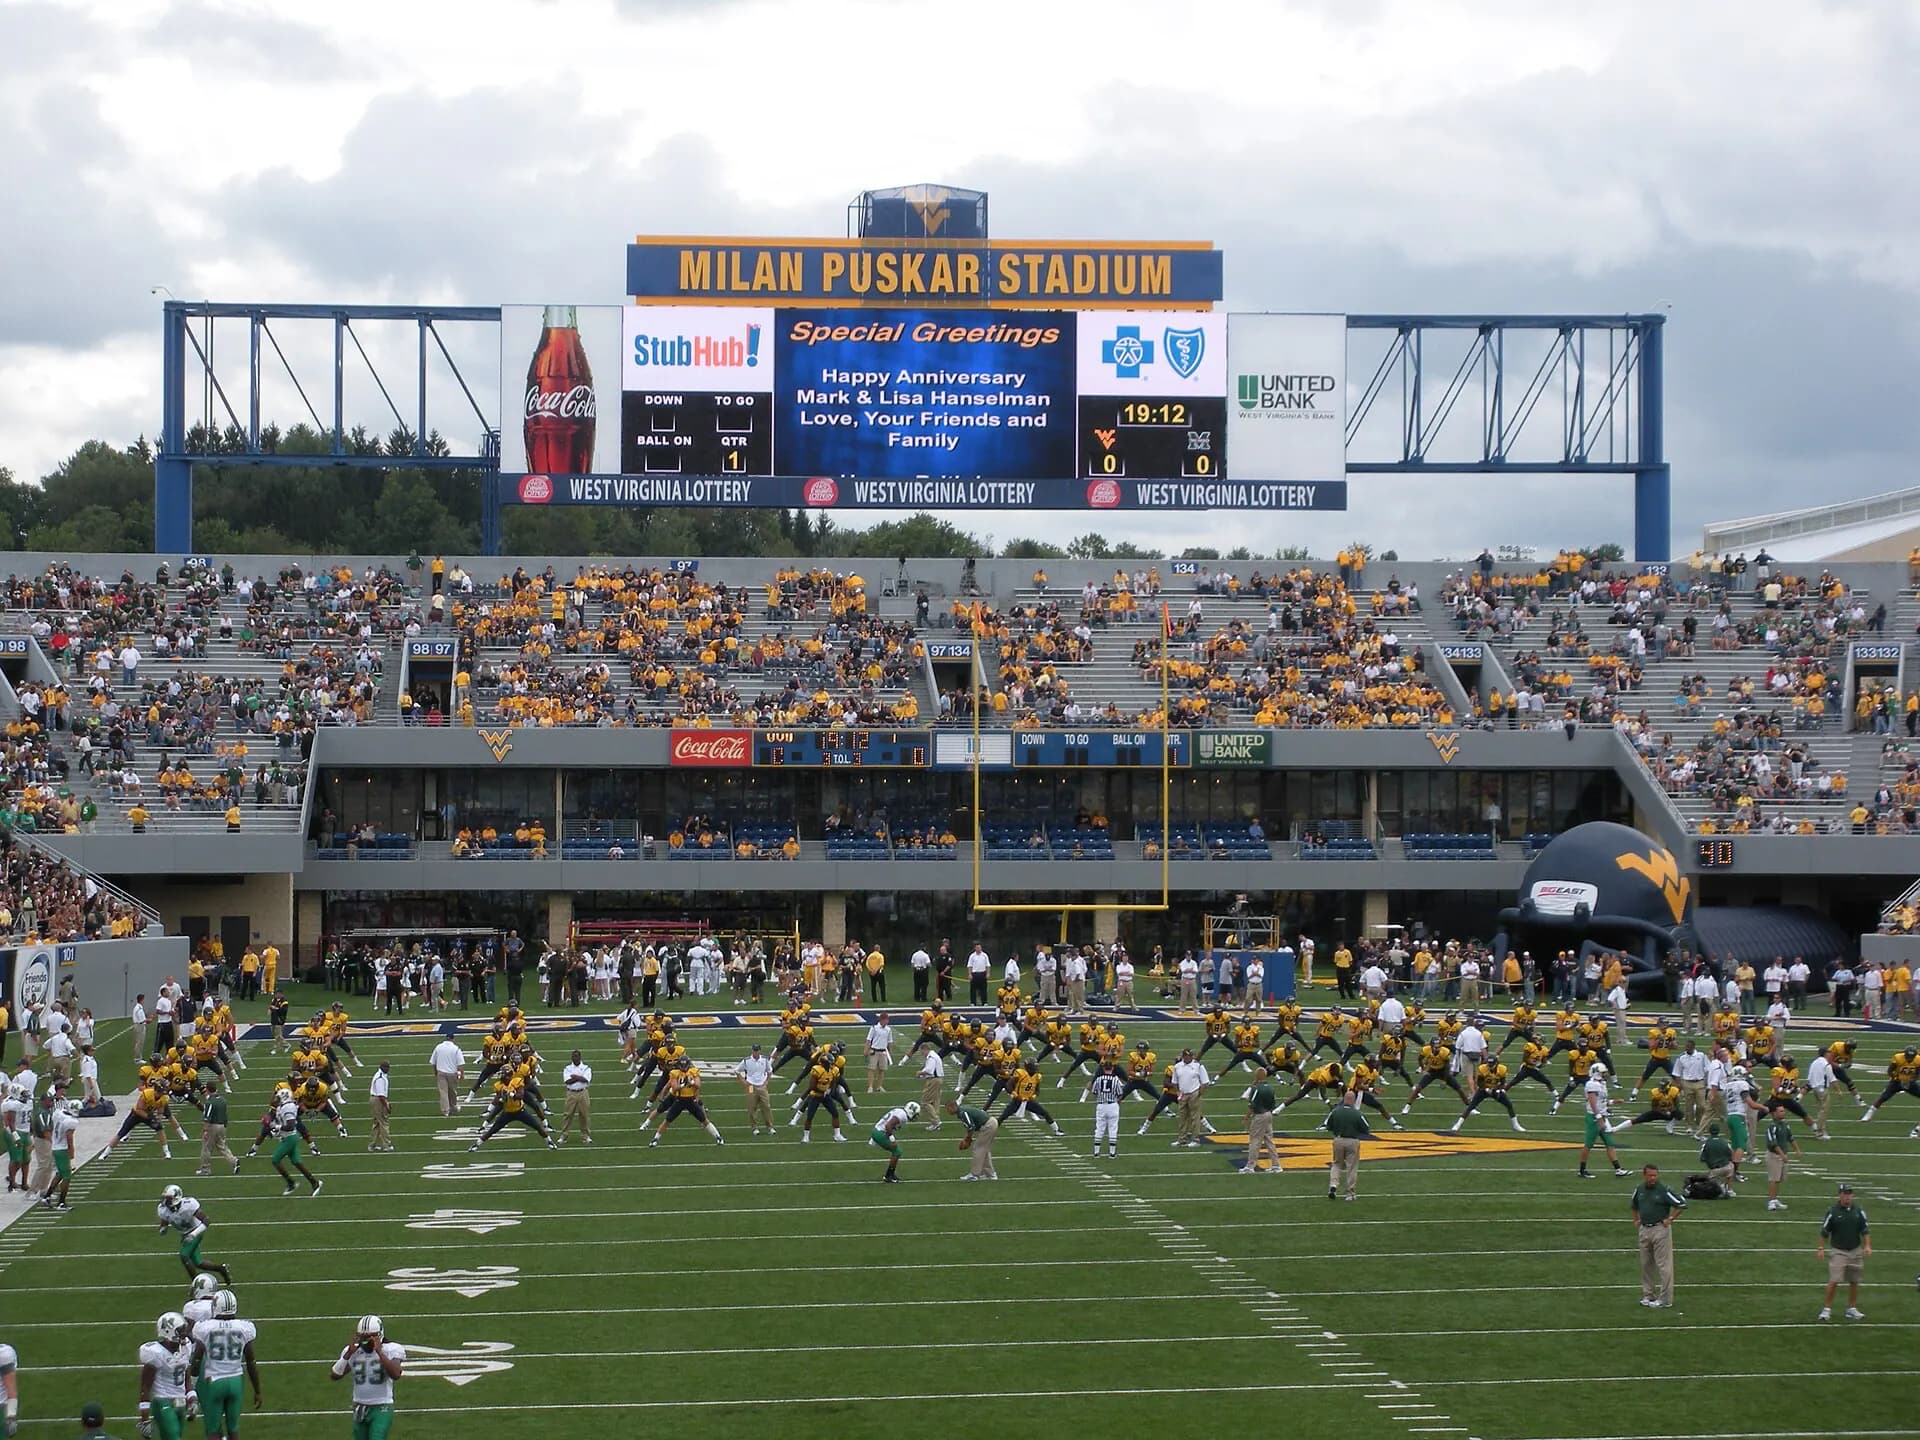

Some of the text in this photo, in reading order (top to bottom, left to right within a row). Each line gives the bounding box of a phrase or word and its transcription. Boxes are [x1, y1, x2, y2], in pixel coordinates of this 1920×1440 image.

[680, 250, 1173, 295] MILAN PUSKAR STADIUM
[790, 321, 1061, 347] Special Greetings
[634, 323, 761, 367] StubHub!
[822, 369, 1026, 388] Happy Anniversary
[1261, 374, 1336, 392] UNITED
[524, 384, 597, 419] Coca-Cola
[645, 395, 683, 405] DOWN
[715, 396, 754, 406] TO GO
[797, 390, 1051, 406] Mark & Lisa Hanselman
[1261, 393, 1315, 409] BANK
[800, 411, 1047, 428] Love, Your Friends and
[1124, 403, 1185, 423] 19:12
[637, 436, 692, 446] BALL ON
[721, 436, 748, 446] QTR
[888, 433, 959, 450] Family
[728, 450, 738, 470] 1
[1103, 454, 1116, 473] 0
[1196, 455, 1210, 474] 0
[570, 478, 612, 501] WEST
[613, 479, 682, 502] VIRGINIA
[685, 480, 752, 502] LOTTERY
[854, 481, 1035, 504] WEST VIRGINIA LOTTERY
[1137, 483, 1316, 507] WEST VIRGINIA LOTTERY
[1175, 564, 1195, 574] 134
[8, 641, 26, 651] 98
[412, 644, 452, 655] 98 97
[930, 645, 970, 656] 97 134
[1461, 647, 1481, 657] 133
[1855, 648, 1899, 658] 133 132
[675, 736, 747, 759] Coca-Cola
[1021, 734, 1045, 745] DOWN
[1064, 734, 1089, 745] TO GO
[1112, 734, 1146, 745] BALL ON
[1214, 734, 1265, 746] UNITED
[913, 747, 924, 766] 0
[1214, 746, 1252, 758] BANK
[1700, 841, 1733, 865] 40
[63, 947, 75, 961] 101
[25, 972, 48, 984] Friends
[1102, 1079, 1111, 1092] L
